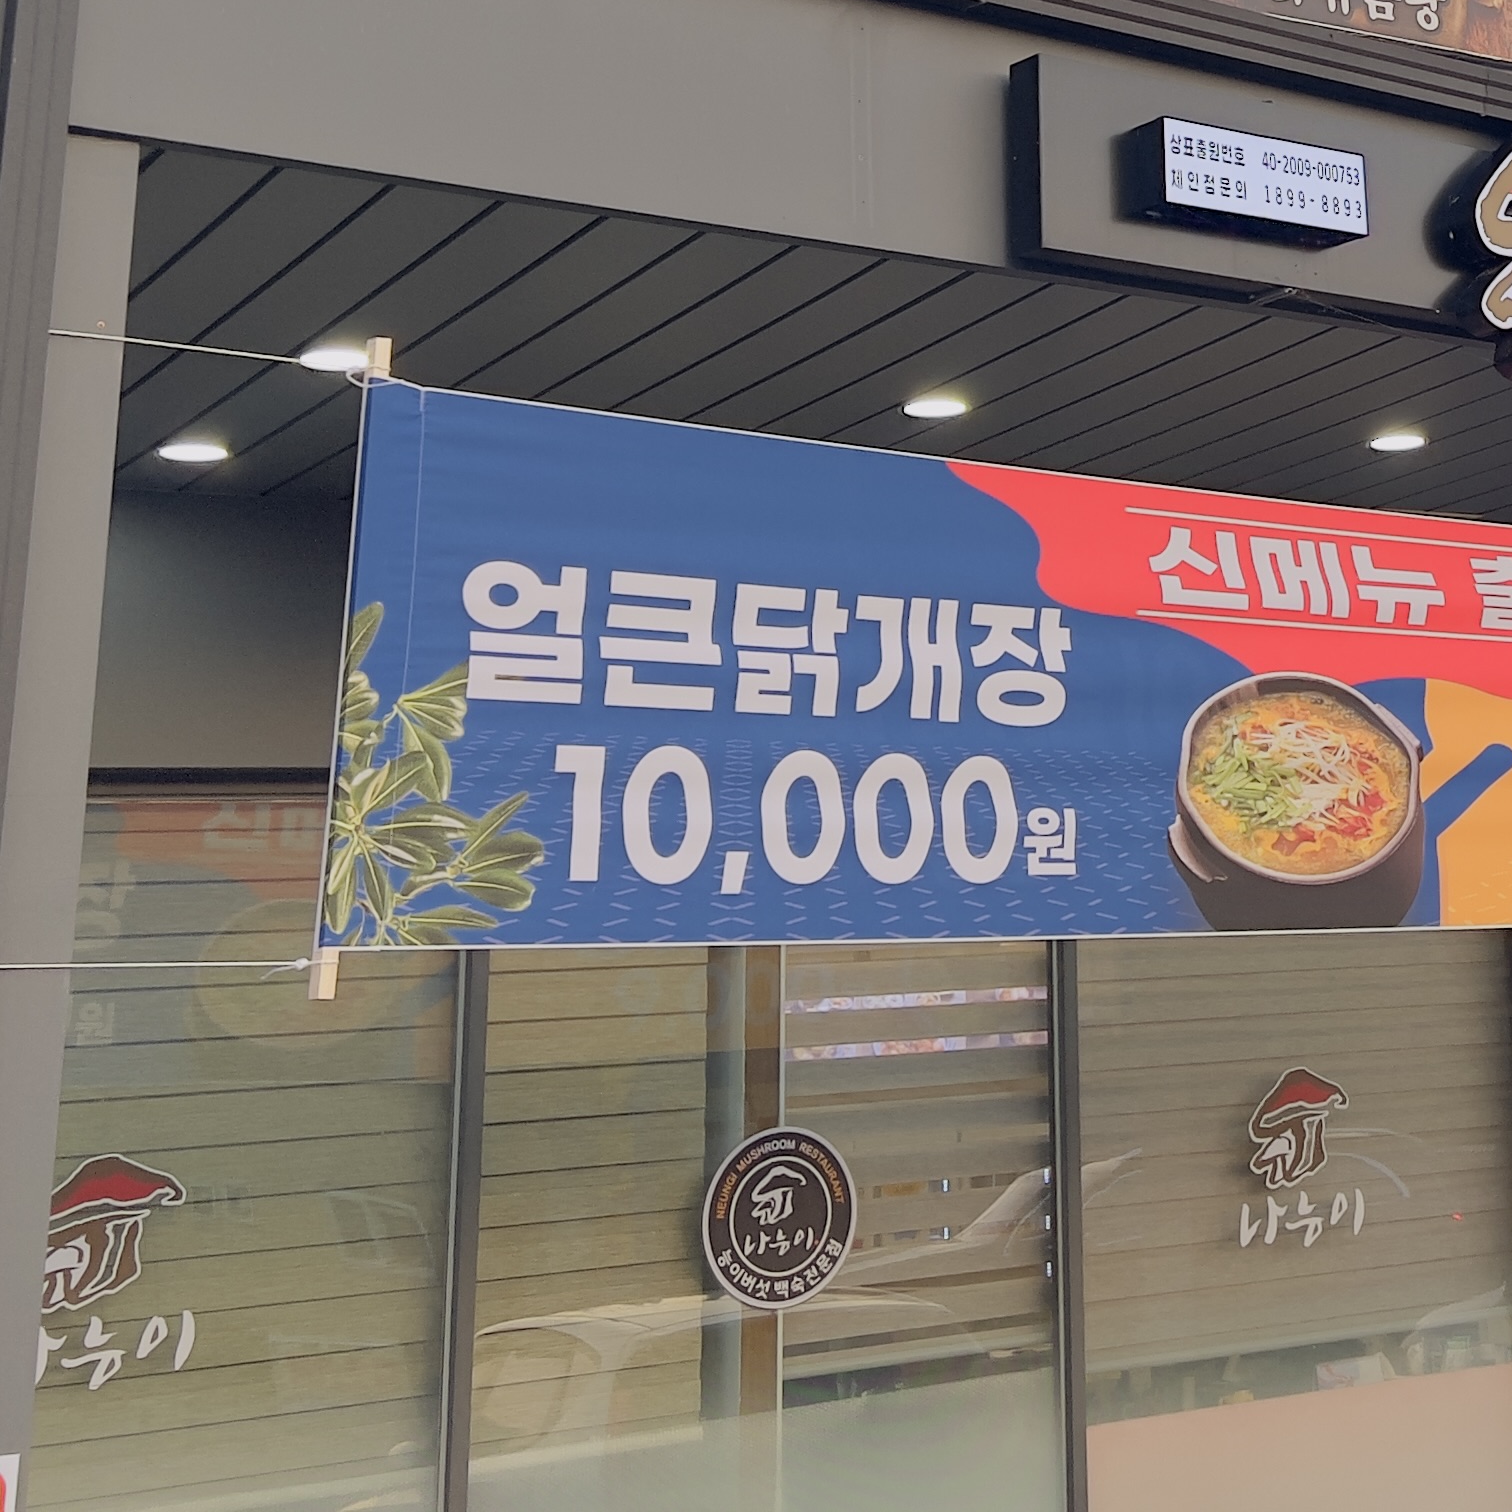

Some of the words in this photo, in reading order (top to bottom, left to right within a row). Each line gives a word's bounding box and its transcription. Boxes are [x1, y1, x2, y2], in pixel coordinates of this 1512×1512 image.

[1170, 134, 1246, 167] 상표출원번호
[1261, 151, 1360, 186] 40-2009-000753
[1264, 185, 1362, 219] 1899-8893
[1148, 525, 1445, 626] 신메뉴
[461, 559, 1073, 728] 얼큰닭개장
[716, 1173, 738, 1220] NEUNGI
[735, 1139, 796, 1172] MUSHROOM
[798, 1141, 846, 1204] RESTAURANT
[743, 1226, 815, 1256] 나능이
[1238, 1188, 1365, 1247] 나능이
[717, 1248, 772, 1300] 능이버섯
